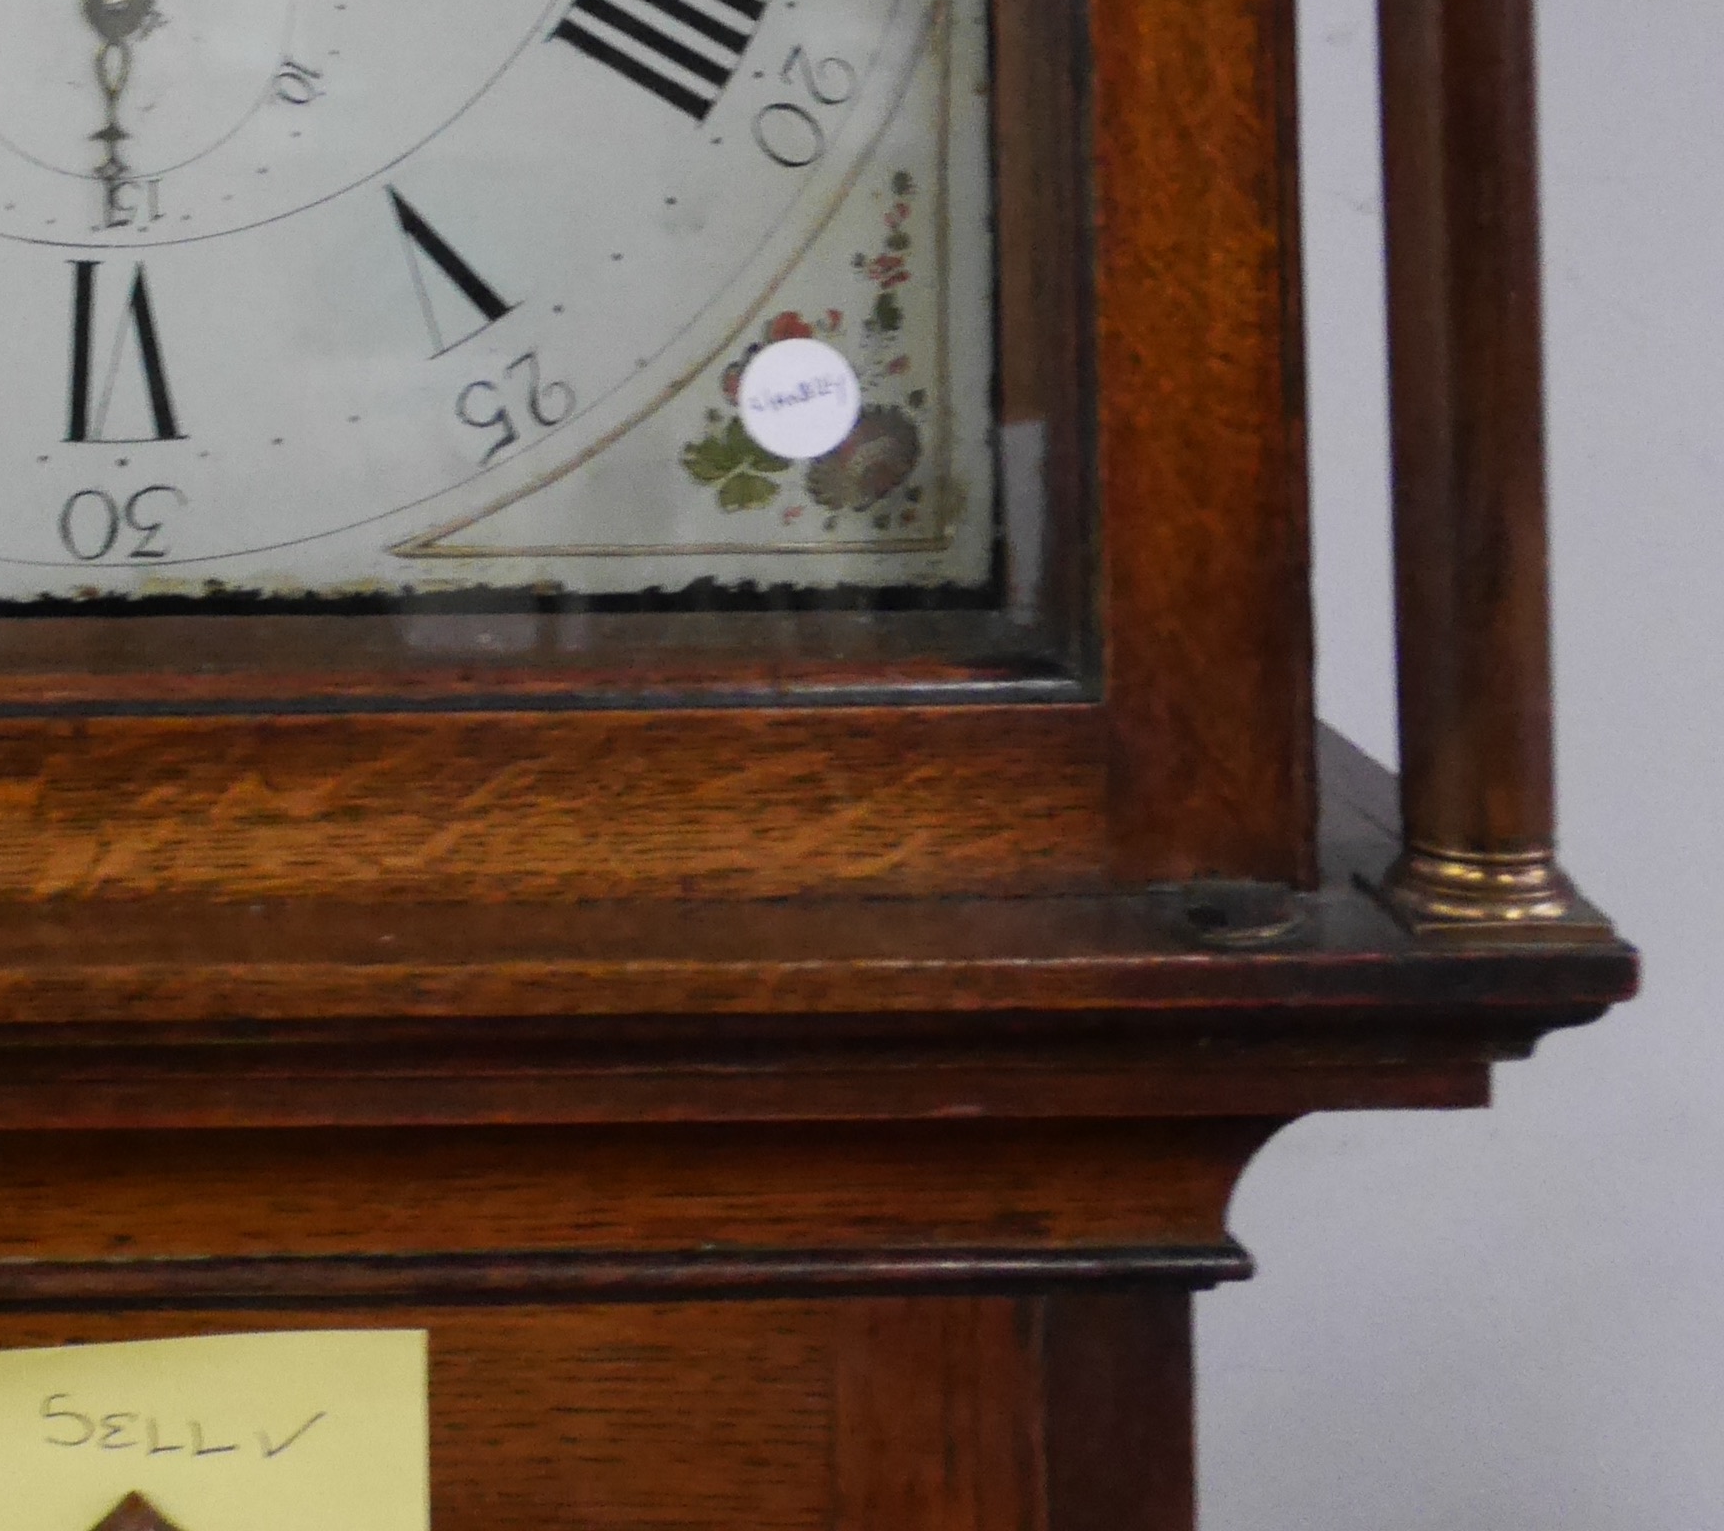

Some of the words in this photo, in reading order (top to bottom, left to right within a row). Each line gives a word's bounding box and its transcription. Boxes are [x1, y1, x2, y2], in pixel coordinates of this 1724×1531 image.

[275, 58, 324, 105] 10
[751, 44, 859, 168] 20
[382, 184, 525, 360] V
[60, 260, 189, 443] VI
[455, 351, 576, 465] 25
[57, 485, 188, 561] 30
[39, 1392, 238, 1457] SELL
